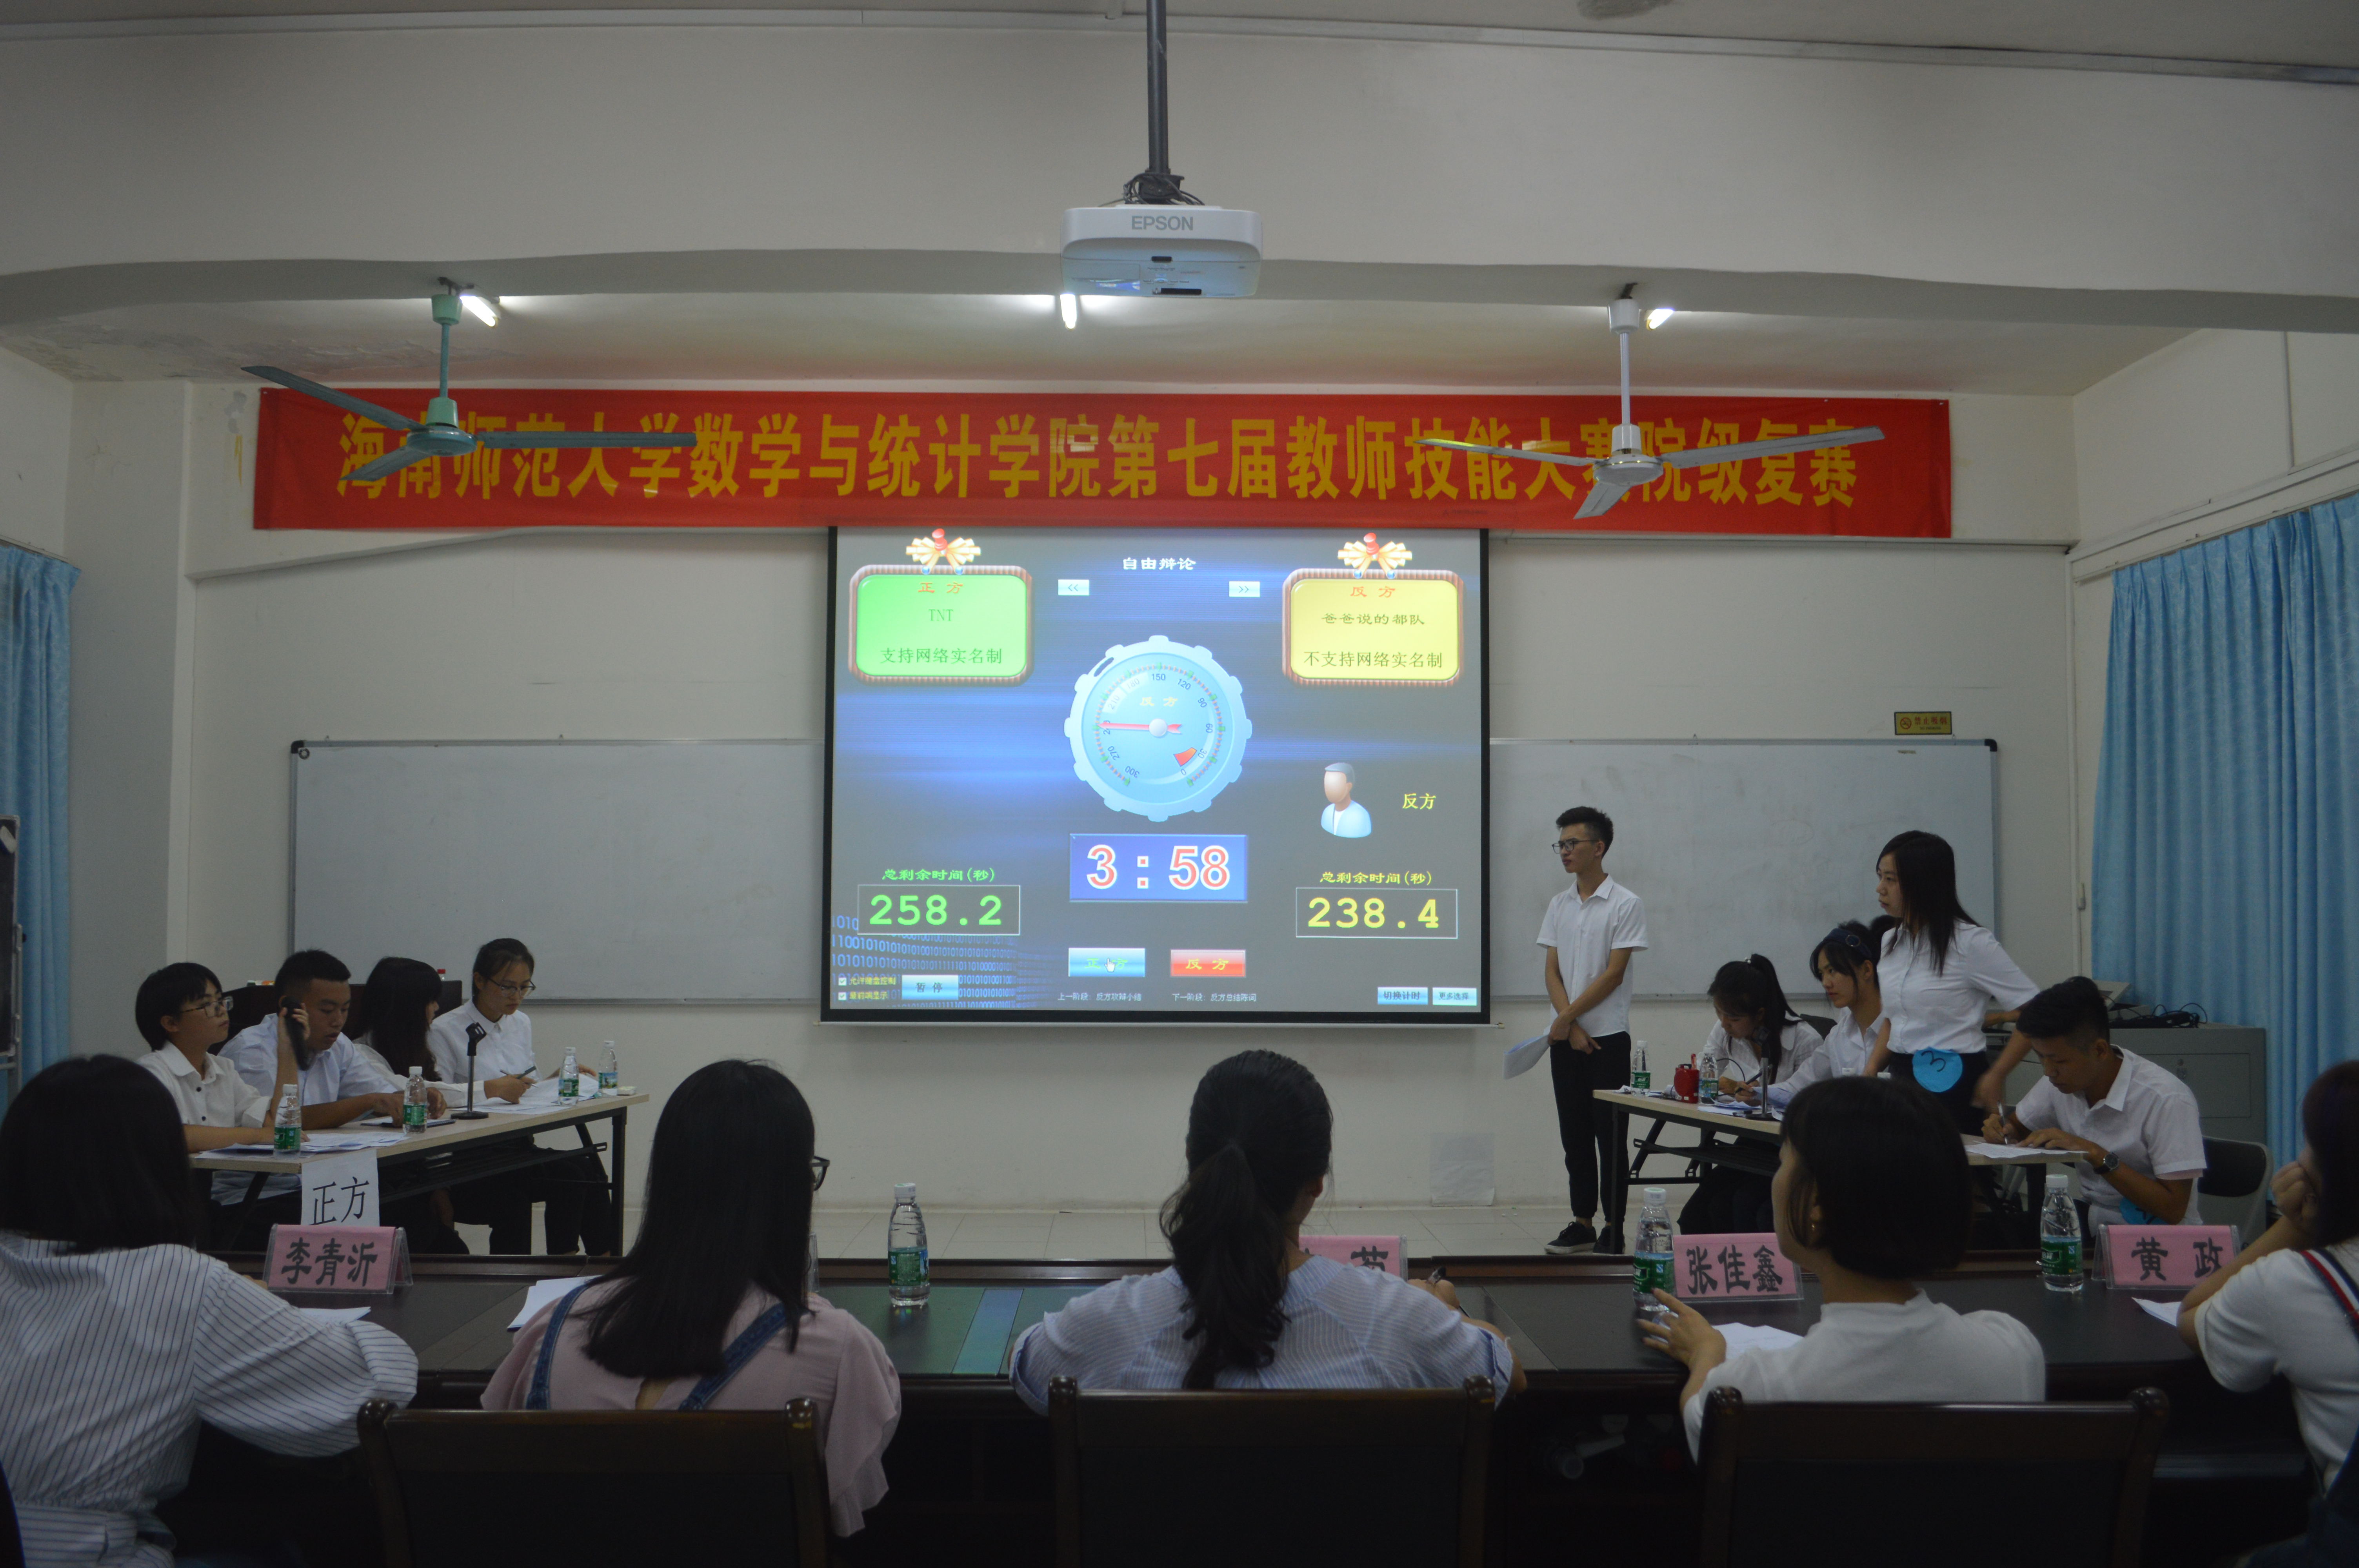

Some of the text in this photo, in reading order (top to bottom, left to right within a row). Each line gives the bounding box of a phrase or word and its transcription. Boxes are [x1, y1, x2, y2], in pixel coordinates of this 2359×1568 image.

[1132, 216, 1193, 230] EPSON
[1123, 557, 1196, 570] 自由辩论
[918, 582, 963, 593] 正方
[1350, 586, 1396, 598] 反方
[929, 609, 953, 621] TNT
[1321, 613, 1425, 625] 爸爸说的都队
[880, 648, 1001, 664] 支持网络实名制
[1303, 651, 1442, 668] 不支持网络实名制
[1126, 678, 1140, 689] 180
[1178, 679, 1191, 690] 120
[1108, 695, 1120, 710] 210
[1197, 697, 1207, 708] 90
[1205, 723, 1213, 733] 60
[1107, 746, 1120, 760] 270
[1198, 748, 1207, 759] 30
[1125, 766, 1140, 778] 300
[1402, 793, 1436, 809] 反方
[869, 894, 1001, 926] 258.2
[1308, 897, 1439, 929] 238.4
[1185, 958, 1229, 970] 反方
[916, 983, 943, 993] 暂停
[1383, 991, 1420, 1000] 切换计时
[1439, 992, 1468, 1000] 更多选择
[309, 1176, 369, 1225] 正方
[282, 1238, 378, 1286] 李青沂
[2131, 1237, 2223, 1281] 黄政
[1687, 1244, 1782, 1294] 张佳鑫
